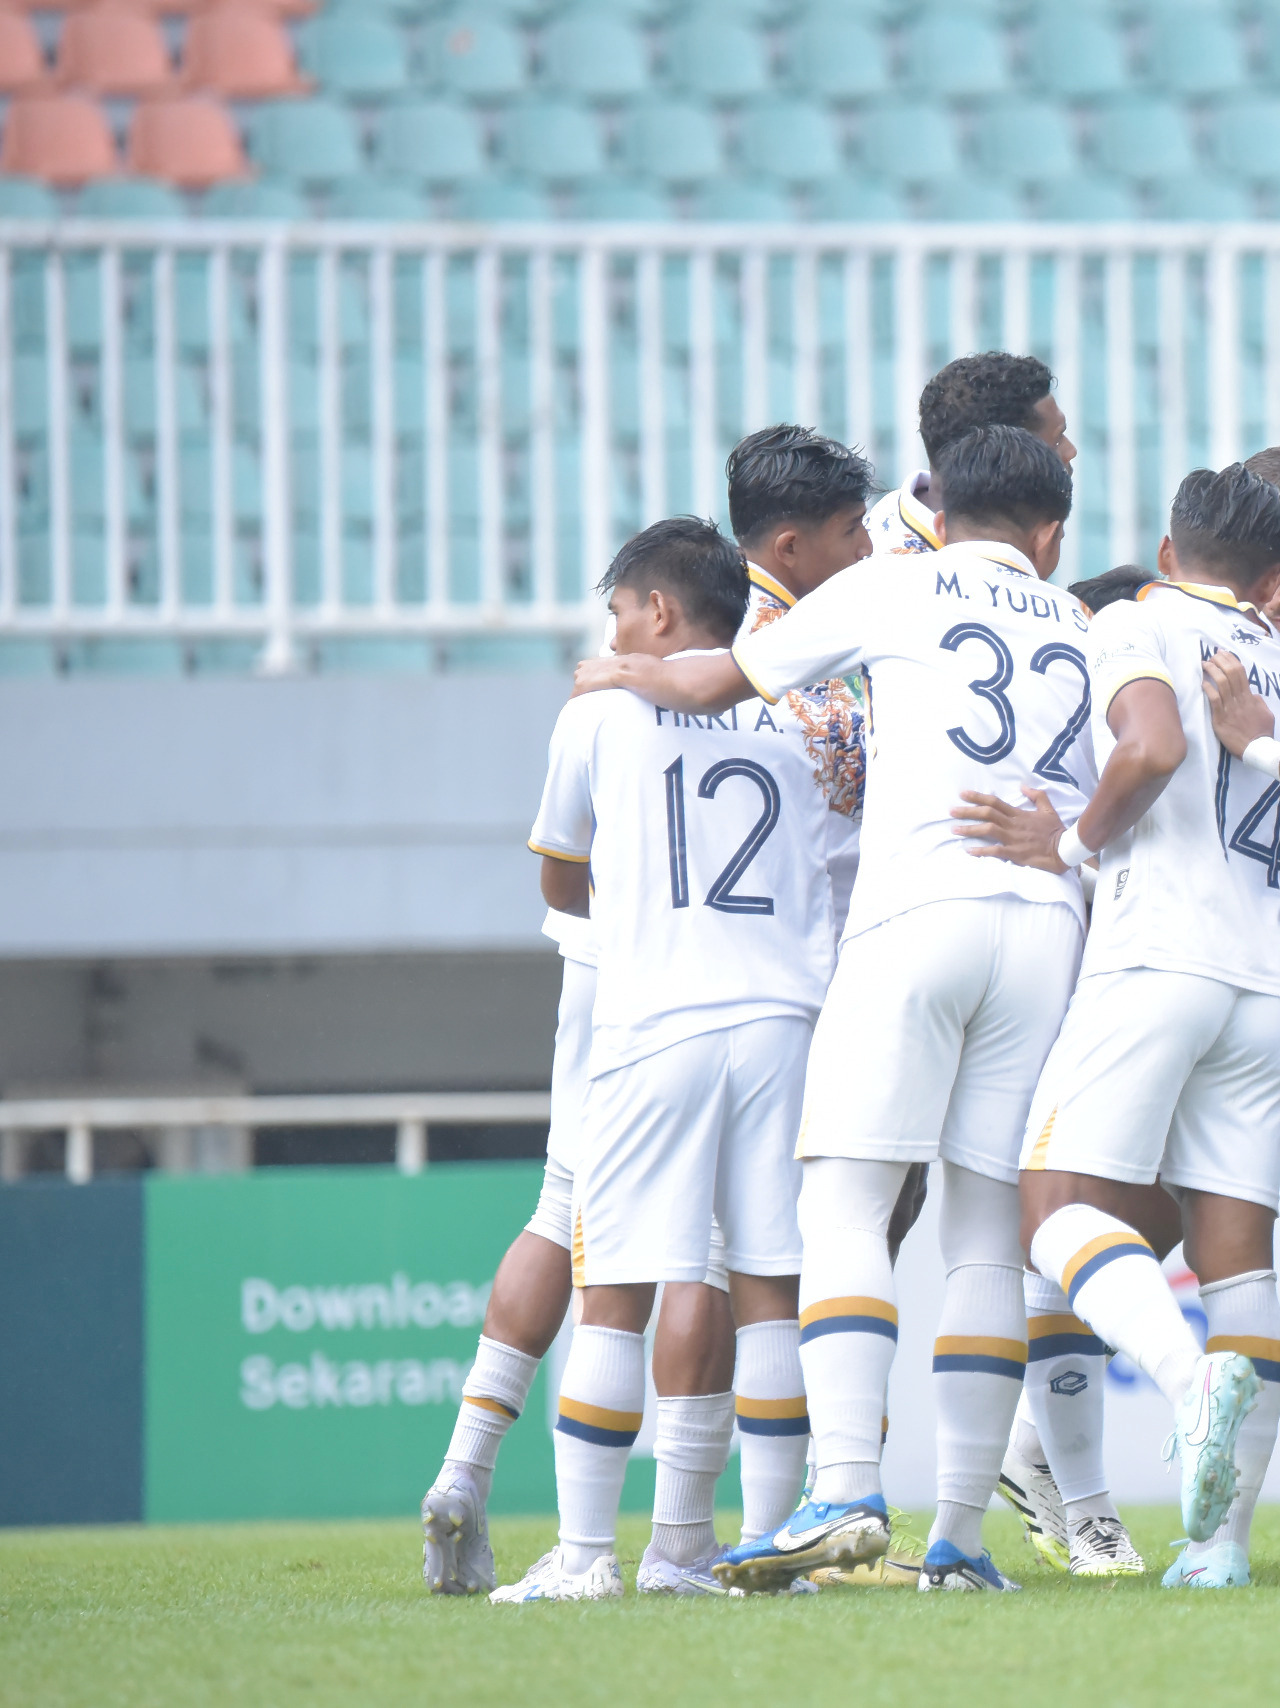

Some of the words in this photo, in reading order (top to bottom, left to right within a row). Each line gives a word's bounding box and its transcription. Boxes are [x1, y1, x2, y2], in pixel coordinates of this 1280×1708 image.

[936, 571, 970, 600] M.
[983, 580, 1061, 623] YUDI
[754, 704, 784, 733] A.
[938, 622, 1092, 791] 32
[663, 753, 782, 916] 12
